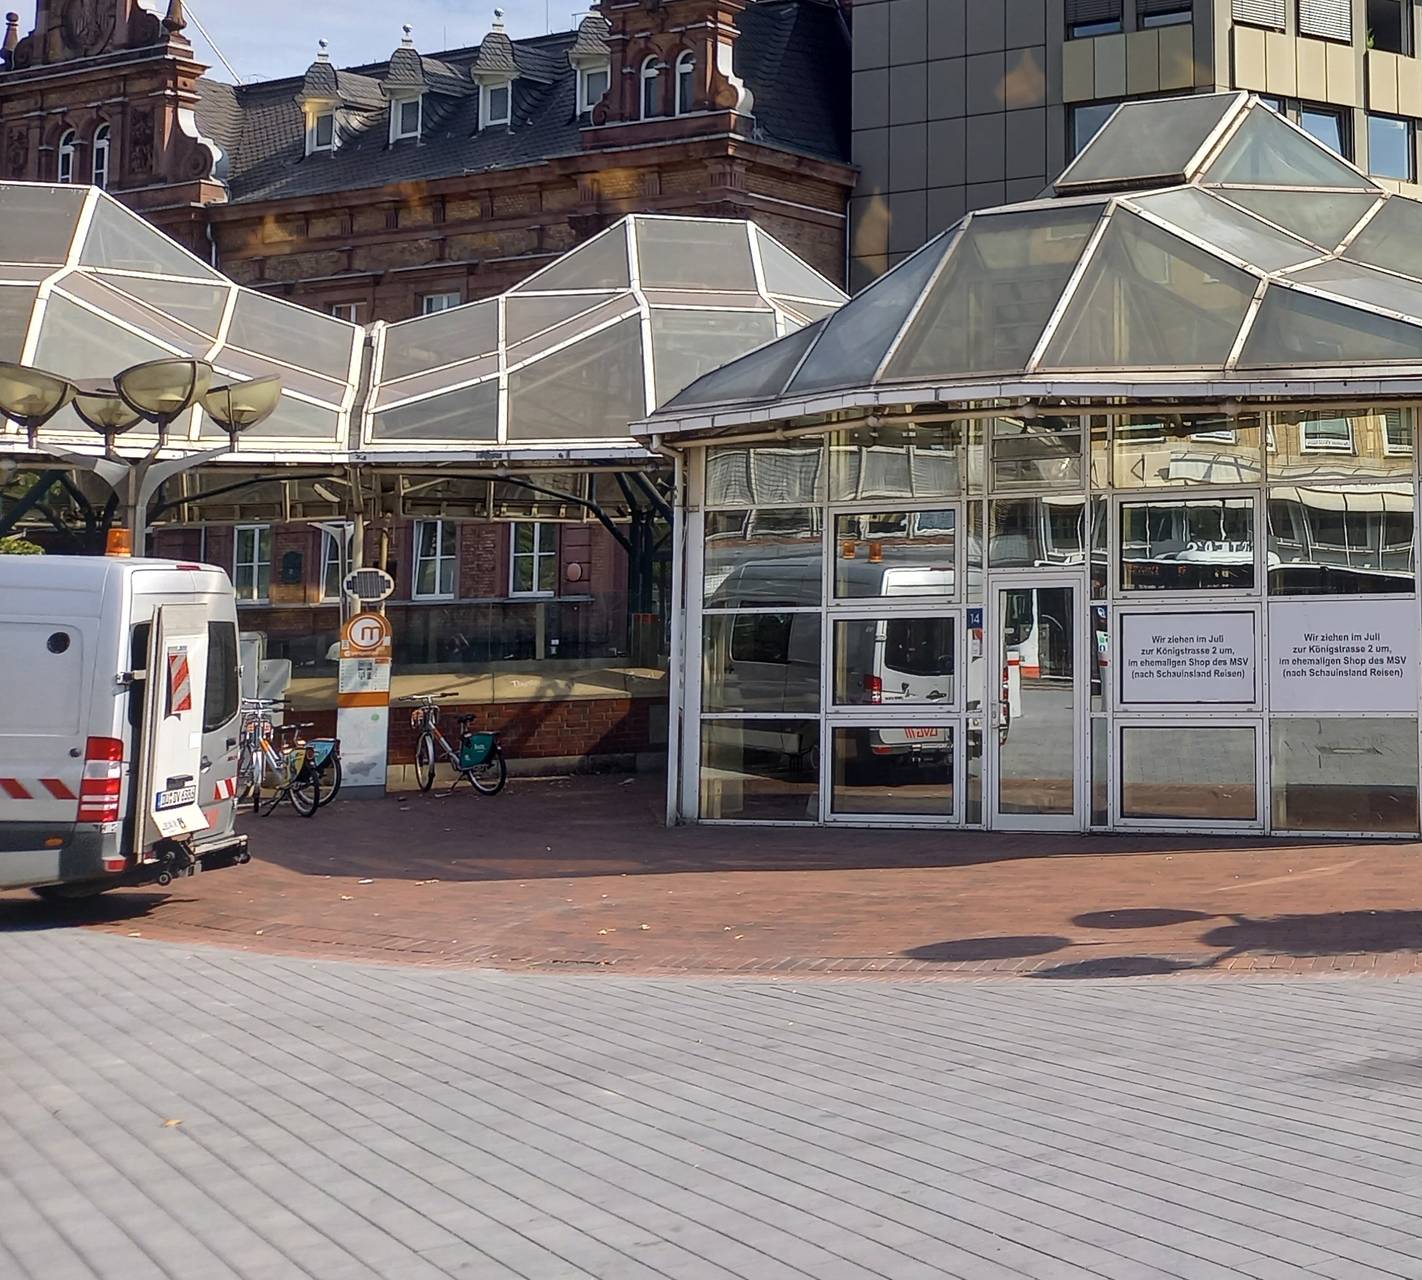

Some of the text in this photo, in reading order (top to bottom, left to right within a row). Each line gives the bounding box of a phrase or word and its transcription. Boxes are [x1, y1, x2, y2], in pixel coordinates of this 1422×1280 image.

[969, 614, 980, 624] 14
[1151, 635, 1224, 643] Wir ziehen im Juli
[1304, 632, 1380, 641] Wir ziehen im Juli
[1156, 646, 1210, 656] Königstrasse
[1212, 646, 1217, 654] 2
[1219, 647, 1235, 655] um,
[1309, 645, 1365, 655] Königstrasse
[1368, 645, 1373, 653] 2
[1375, 646, 1392, 654] um,
[1140, 658, 1187, 668] ehemaligen
[1189, 658, 1211, 667] Shop
[1212, 658, 1228, 666] des
[1229, 657, 1249, 666] MSV
[1279, 656, 1407, 666] im ehemaligen Shop des MSV
[1131, 669, 1245, 679] (nach Schauinsland Reisen)
[1282, 668, 1403, 678] (nach Schauinsland Reisen)
